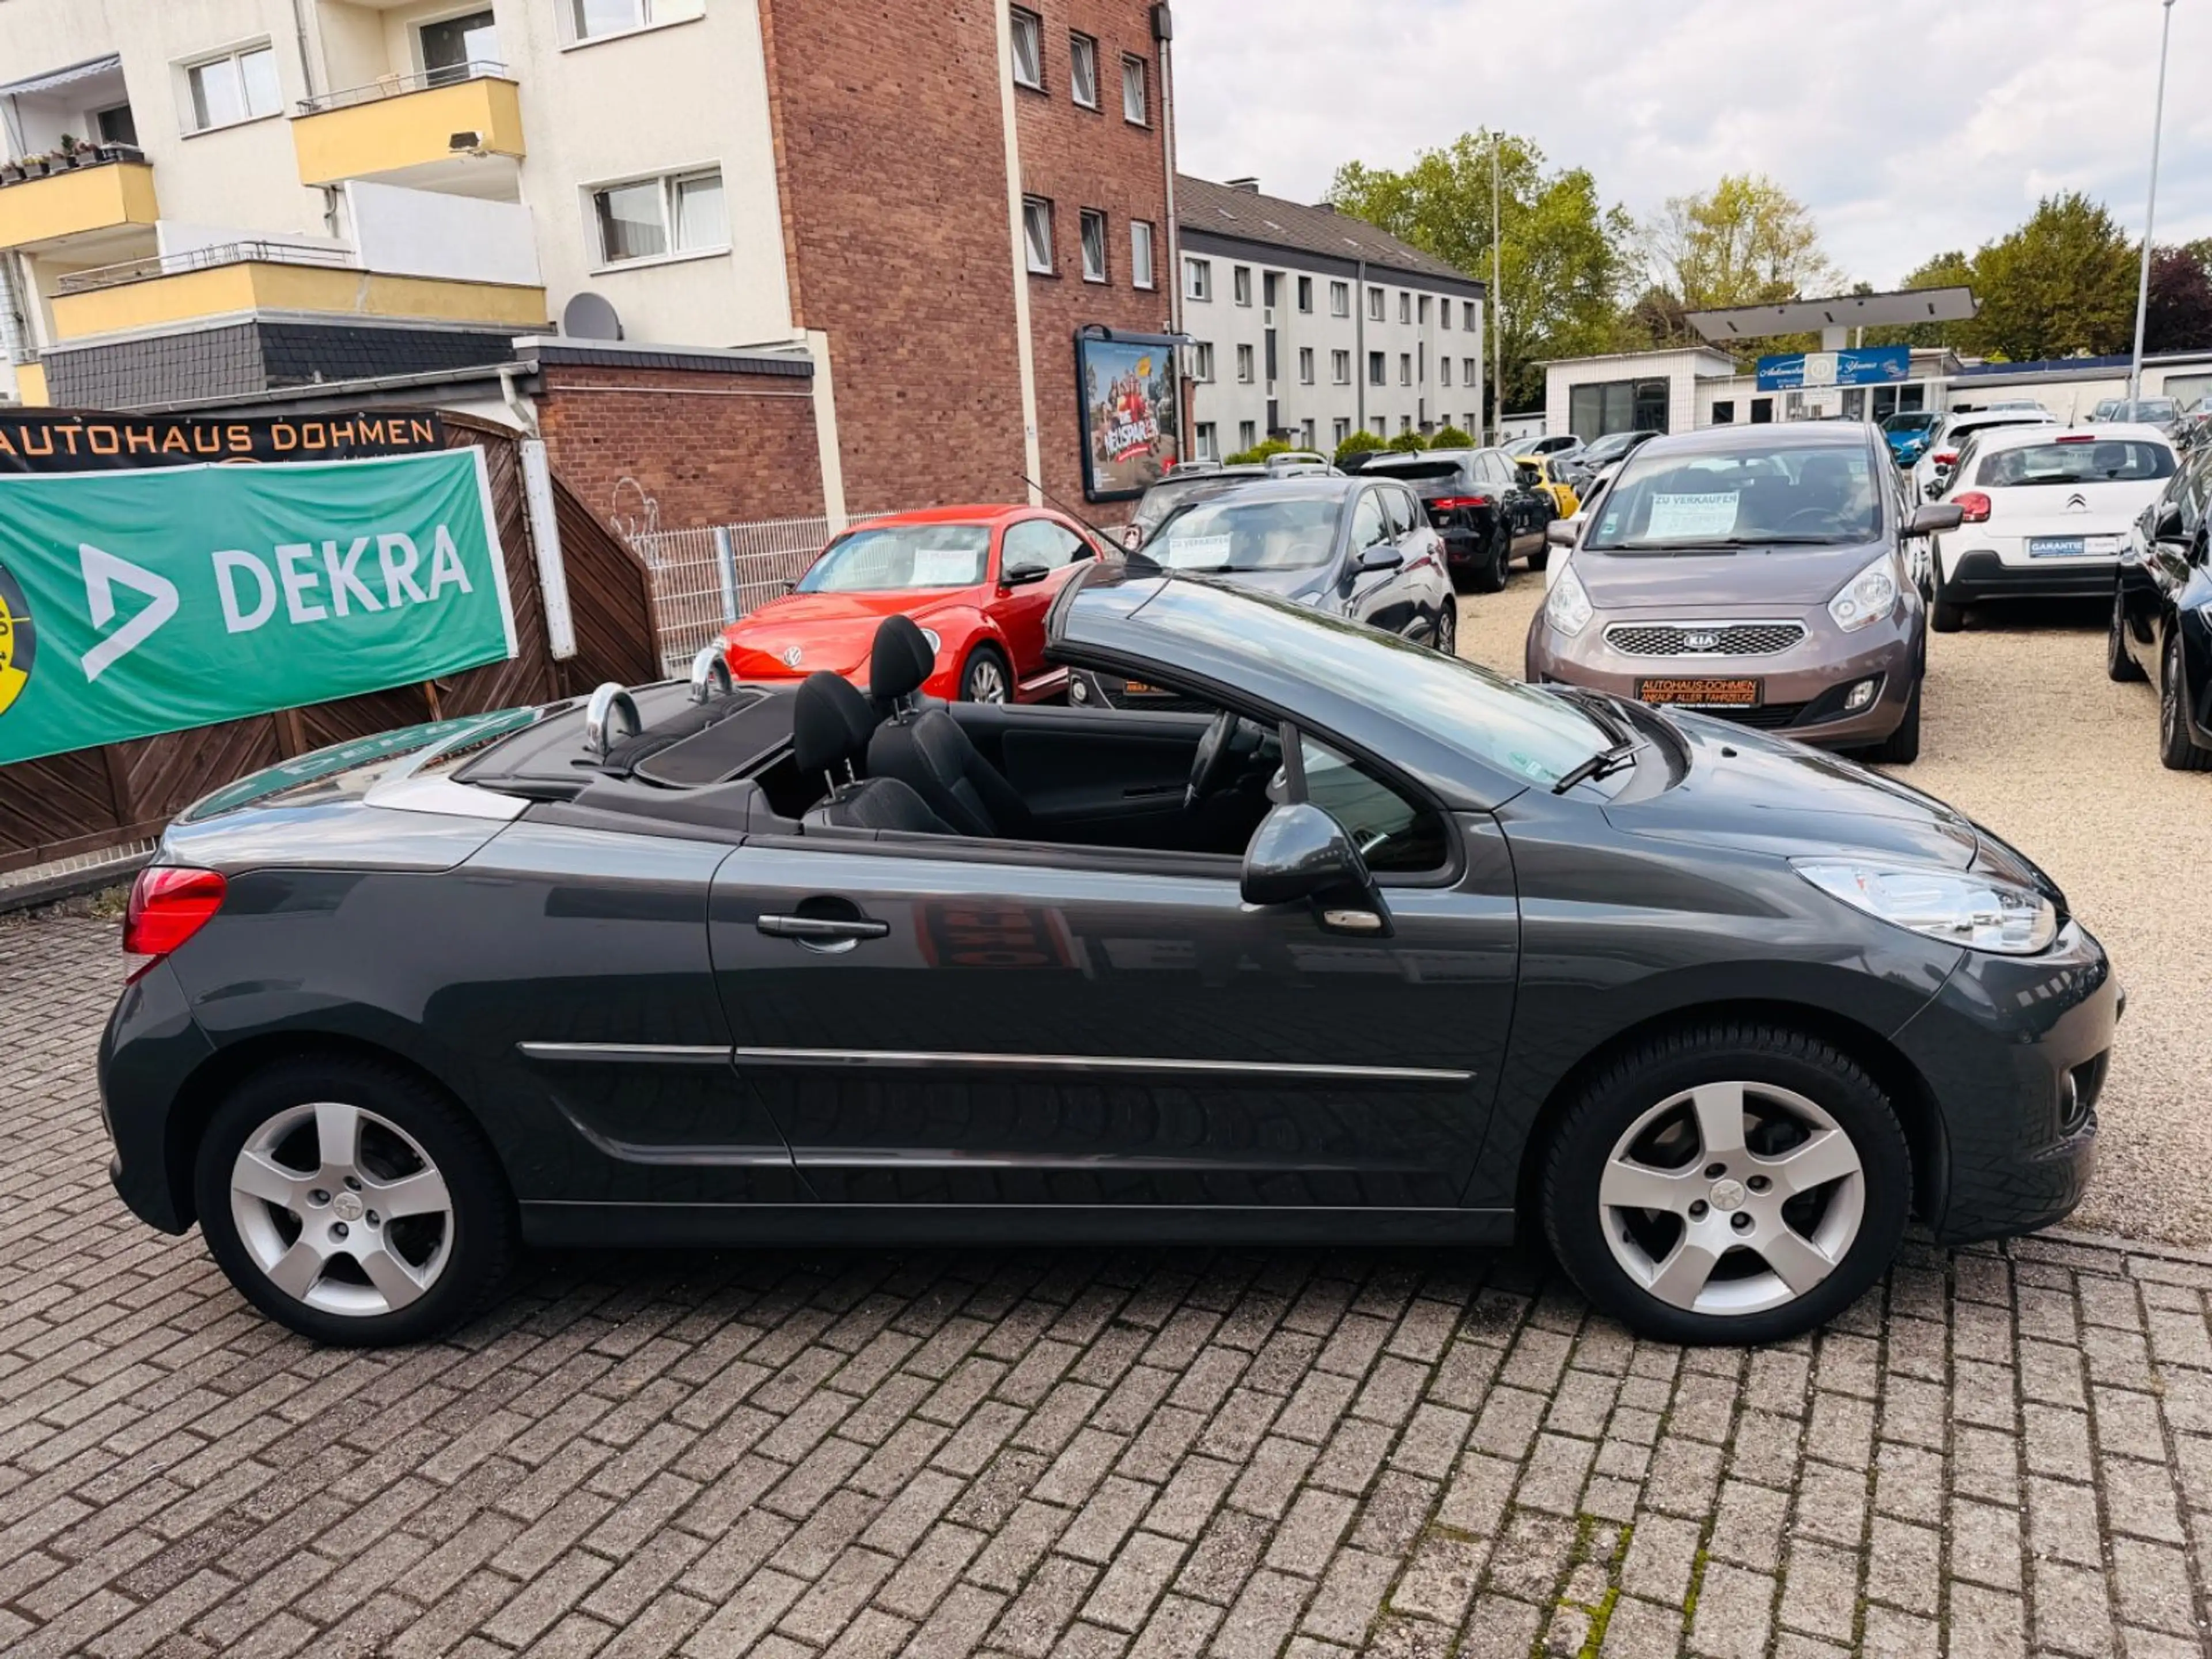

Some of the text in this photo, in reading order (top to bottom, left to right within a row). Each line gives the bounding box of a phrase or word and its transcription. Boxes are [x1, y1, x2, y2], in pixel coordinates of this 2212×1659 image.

[0, 419, 434, 455] AUTOHAUS DOHMEN
[2032, 541, 2083, 551] GARANTIE
[211, 524, 473, 633] DEKRA
[1689, 635, 1713, 645] KIA
